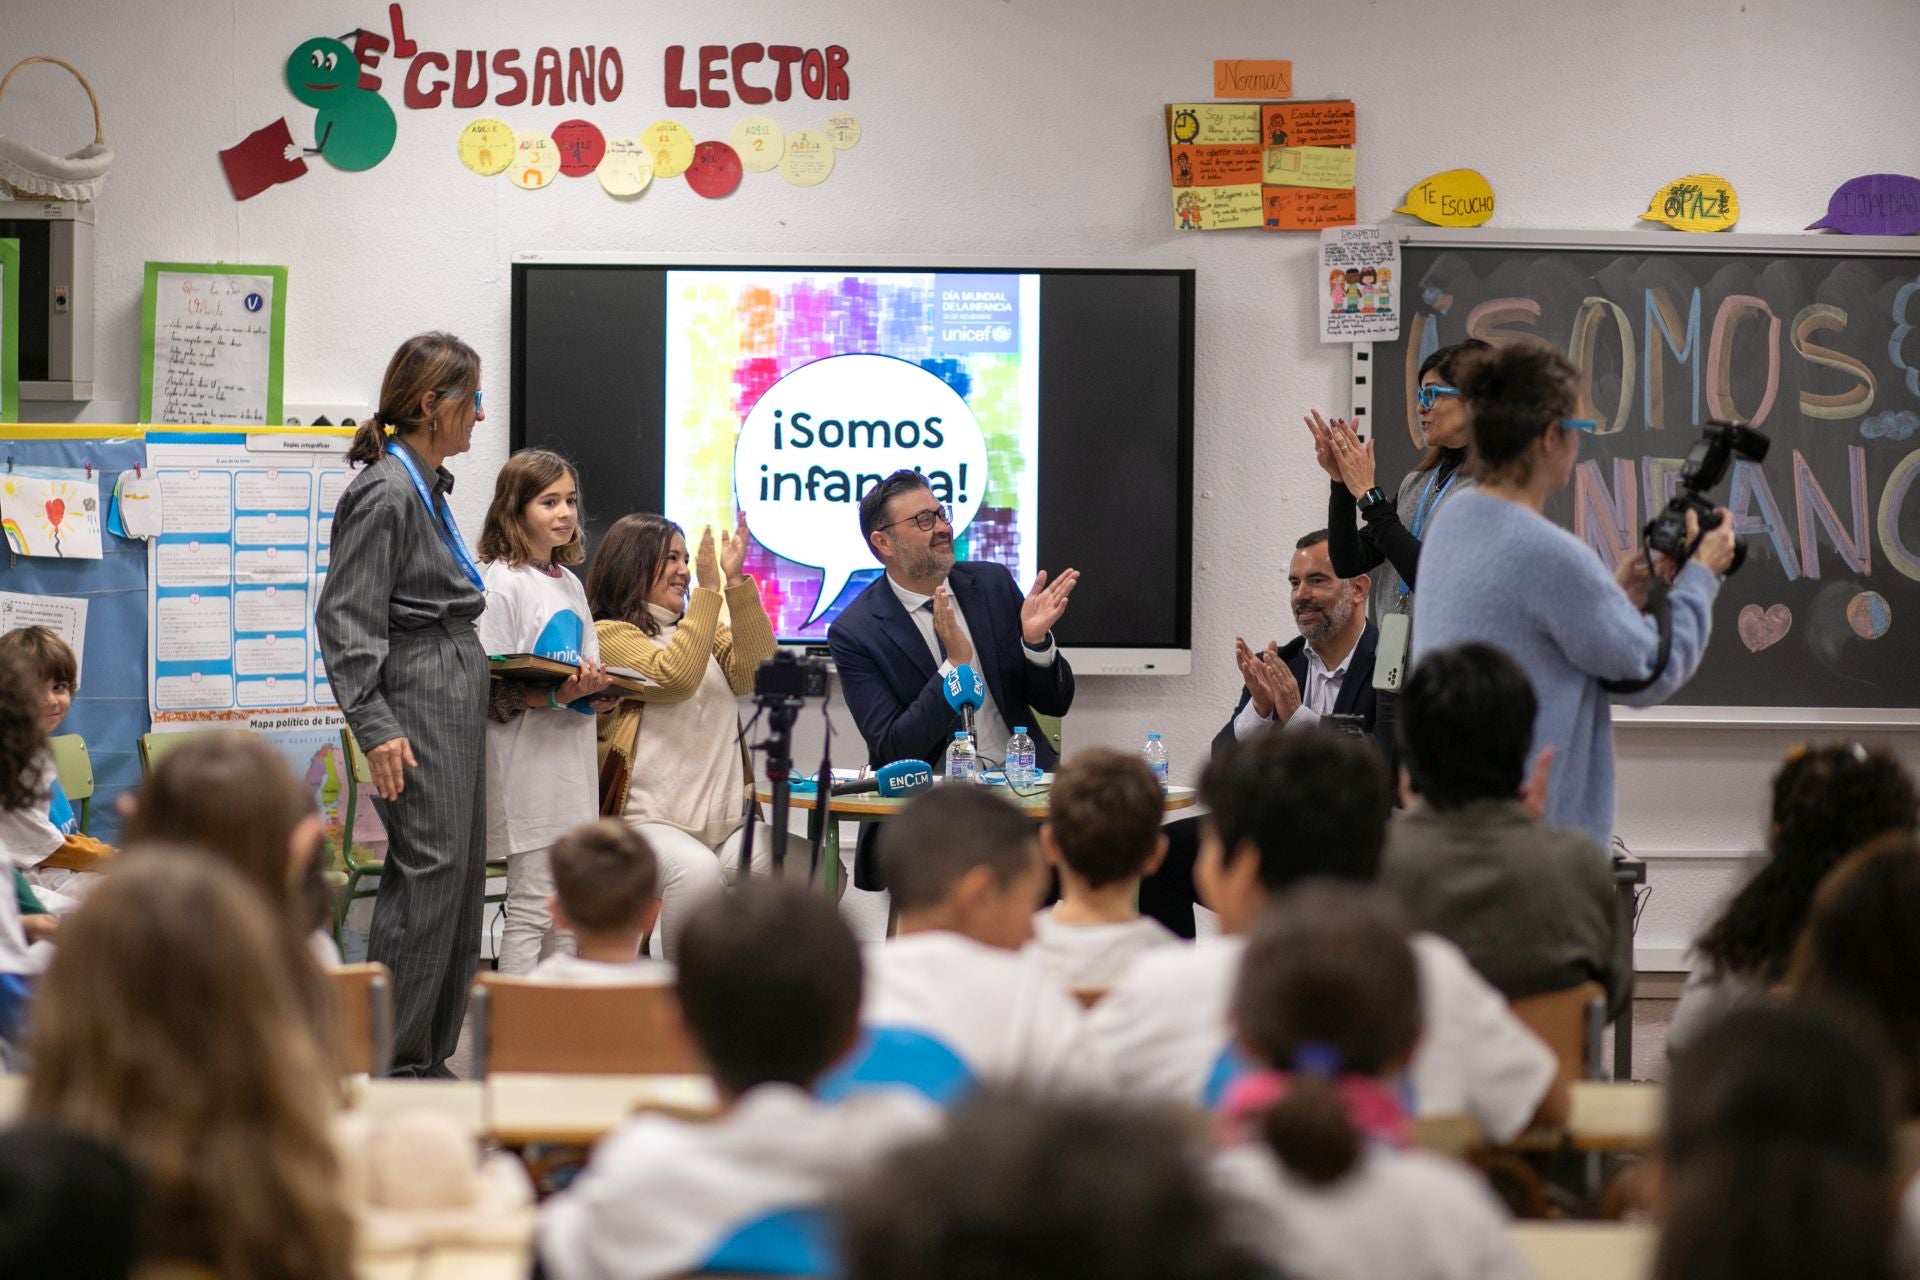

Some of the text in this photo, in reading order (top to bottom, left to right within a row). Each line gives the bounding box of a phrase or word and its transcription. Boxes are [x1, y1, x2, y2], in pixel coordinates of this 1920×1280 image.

[403, 44, 625, 108] GUSANO
[664, 42, 850, 108] LECTOR
[1217, 61, 1290, 93] Normas
[752, 139, 764, 151] 2
[1419, 182, 1436, 204] TE
[1441, 194, 1494, 216] ESCUCHO
[1680, 191, 1720, 220] PAZ
[1340, 228, 1380, 241] RESPETO
[942, 289, 1007, 302] DÍA MUNDIAL
[942, 302, 1013, 312] DE LA INFANCIA
[942, 326, 993, 342] unicef
[774, 410, 944, 450] ¡Somos
[283, 441, 330, 450] Reglas ortográficas
[760, 463, 968, 504] infana!
[546, 645, 578, 663] unic
[250, 714, 346, 730] Mapa político de Euro
[889, 770, 930, 790] ENCLM
